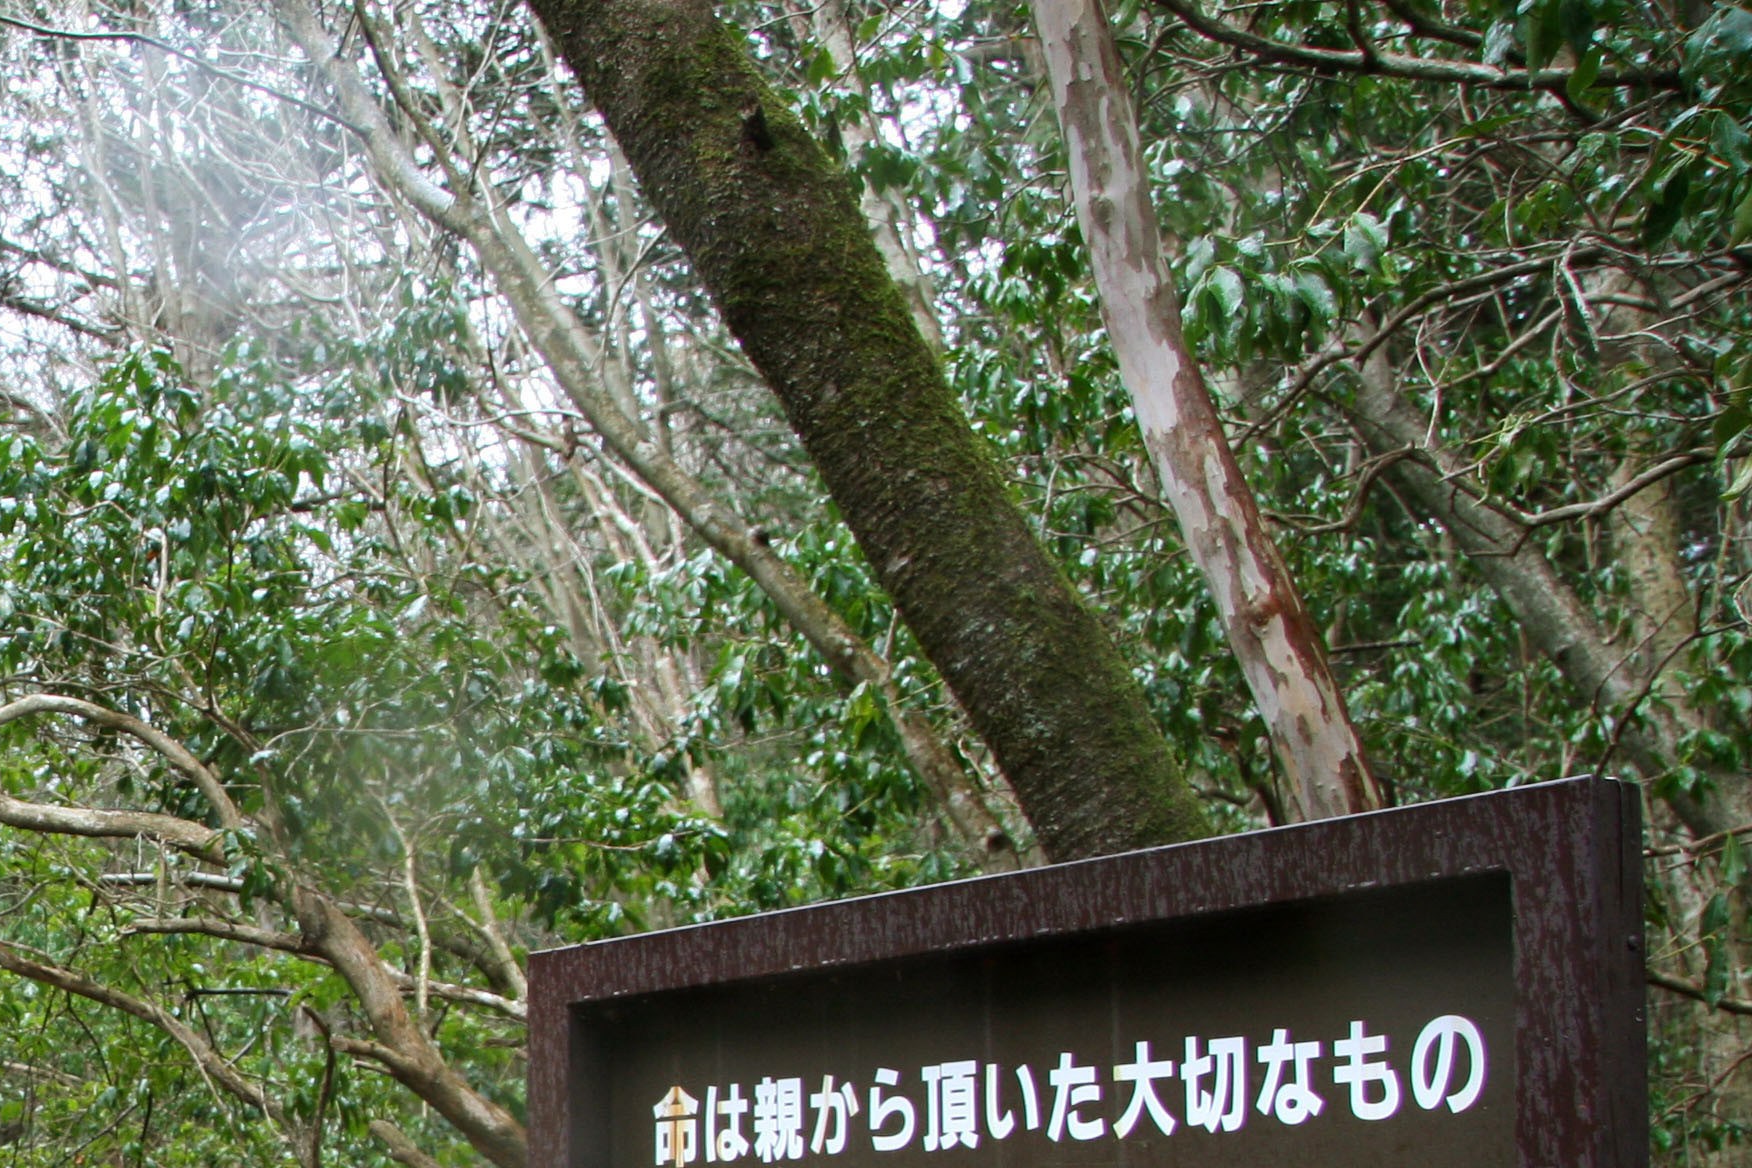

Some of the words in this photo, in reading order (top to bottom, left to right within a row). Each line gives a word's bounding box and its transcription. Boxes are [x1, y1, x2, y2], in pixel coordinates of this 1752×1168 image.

[652, 1014, 1486, 1168] 命は親から頂いた大切なもの
